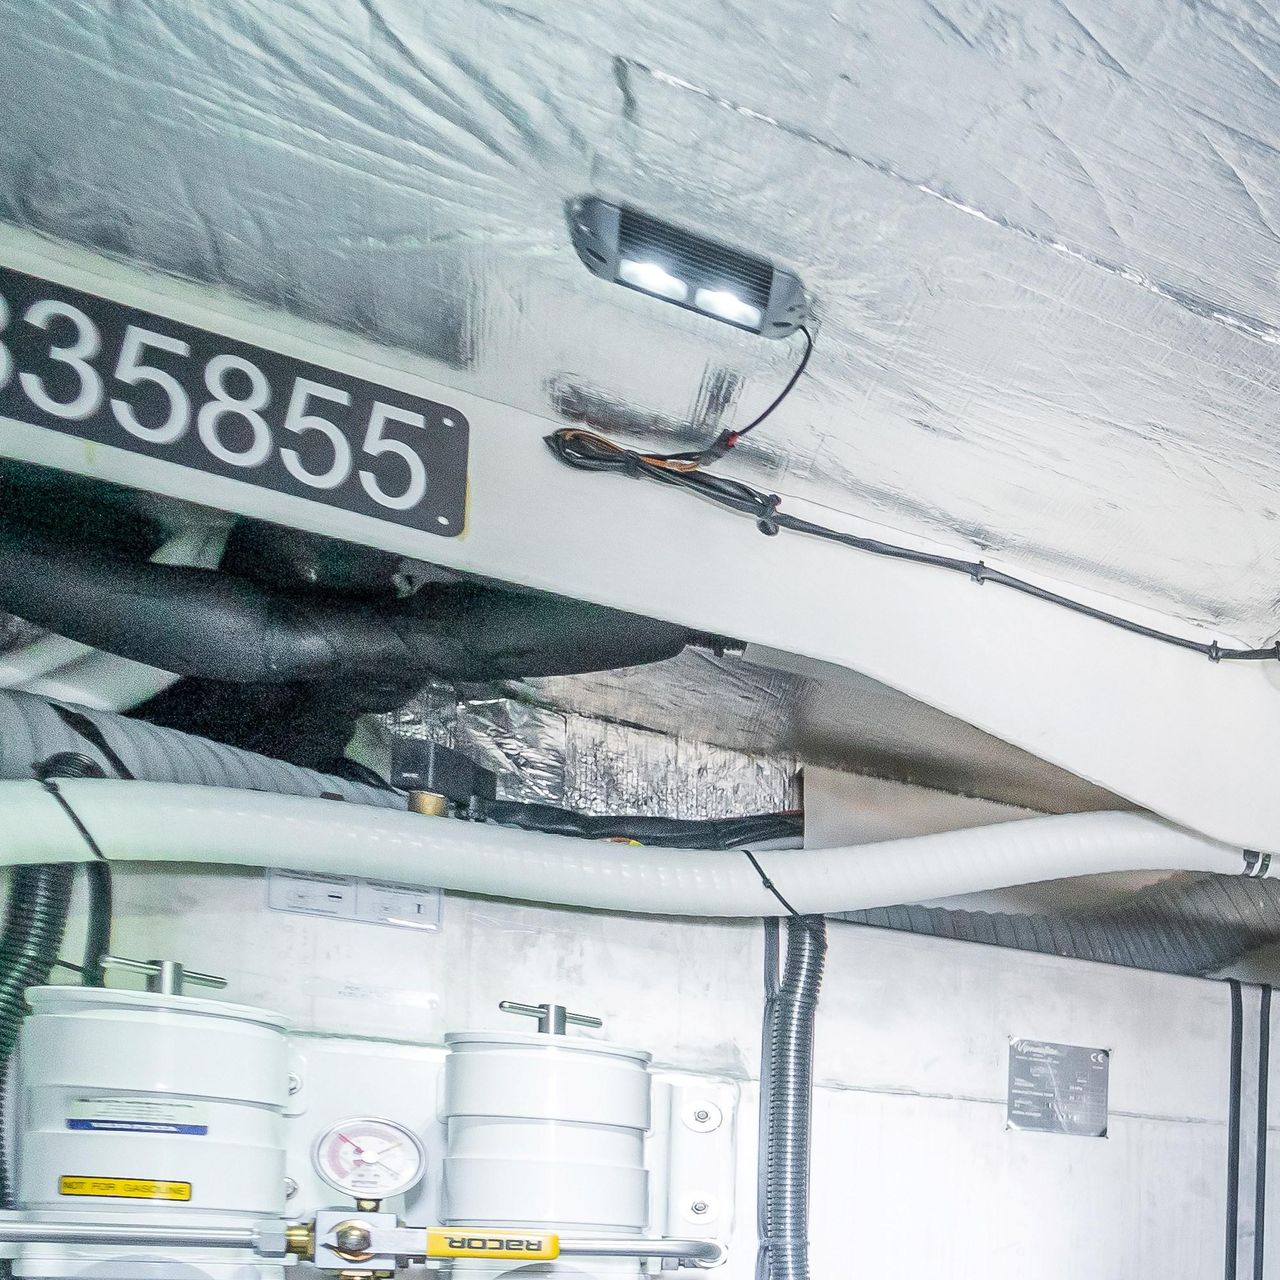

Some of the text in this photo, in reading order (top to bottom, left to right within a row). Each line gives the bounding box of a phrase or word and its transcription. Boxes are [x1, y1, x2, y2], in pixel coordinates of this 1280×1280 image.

[0, 291, 427, 510] 35855
[63, 1181, 187, 1195] NOT FOR GASOLINE
